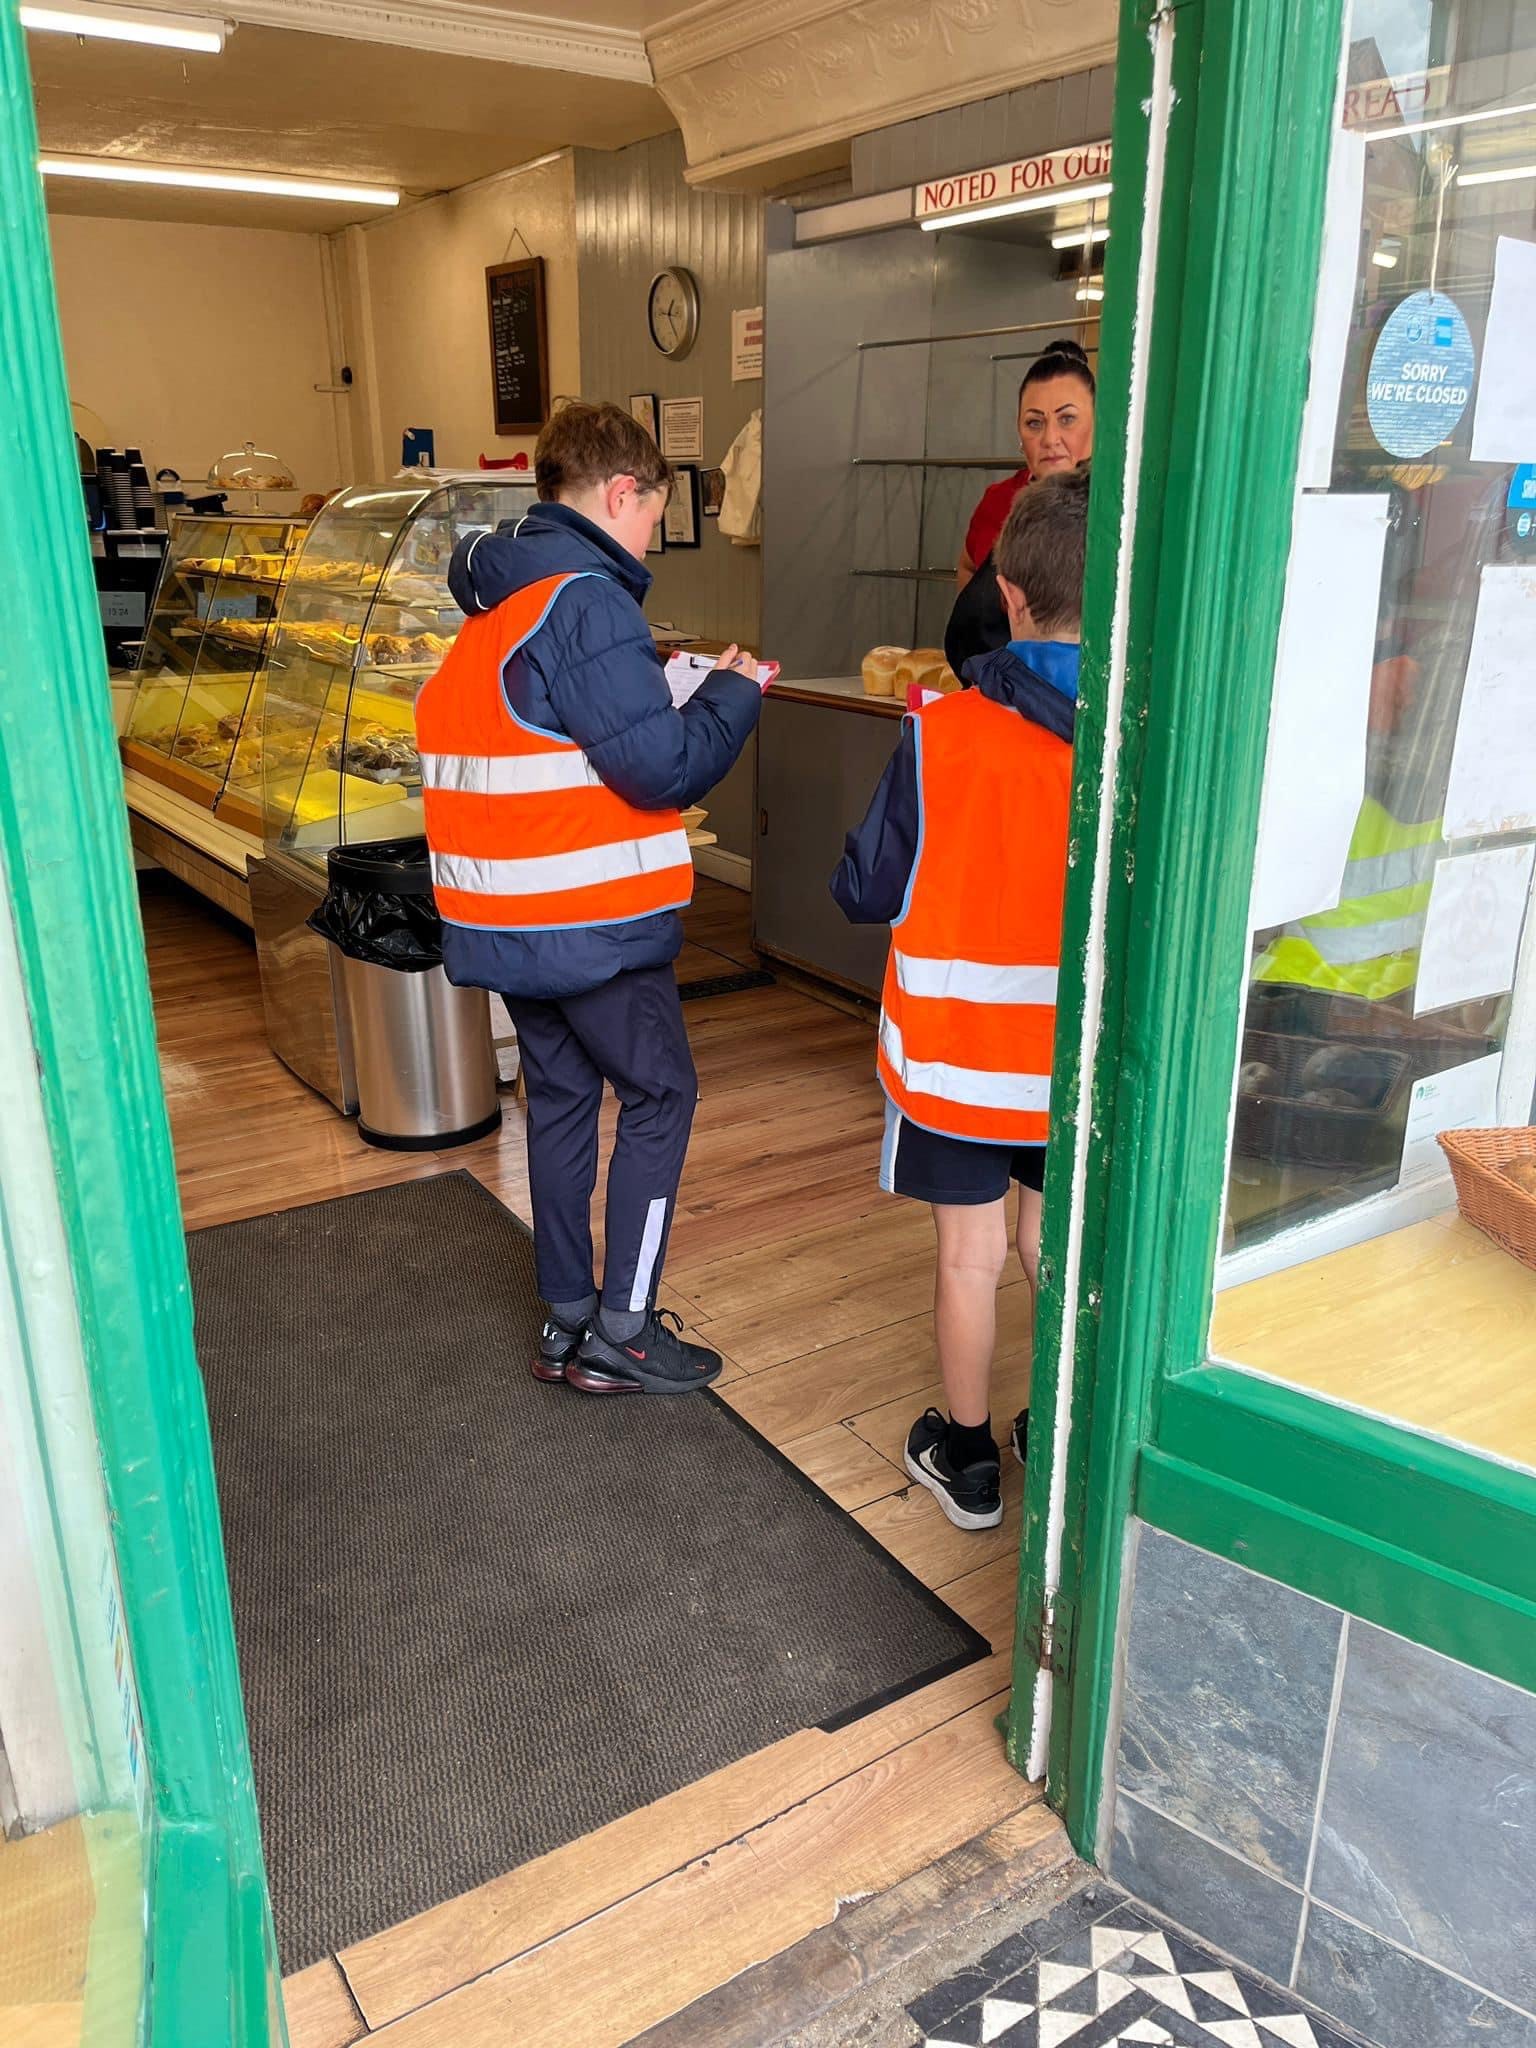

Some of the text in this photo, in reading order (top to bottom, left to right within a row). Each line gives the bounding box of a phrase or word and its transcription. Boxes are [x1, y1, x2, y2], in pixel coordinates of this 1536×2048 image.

[924, 171, 996, 212] NOTED
[1011, 159, 1055, 193] FOR
[1401, 361, 1448, 383] SORRY
[1371, 382, 1468, 405] WE'RE CLOSED
